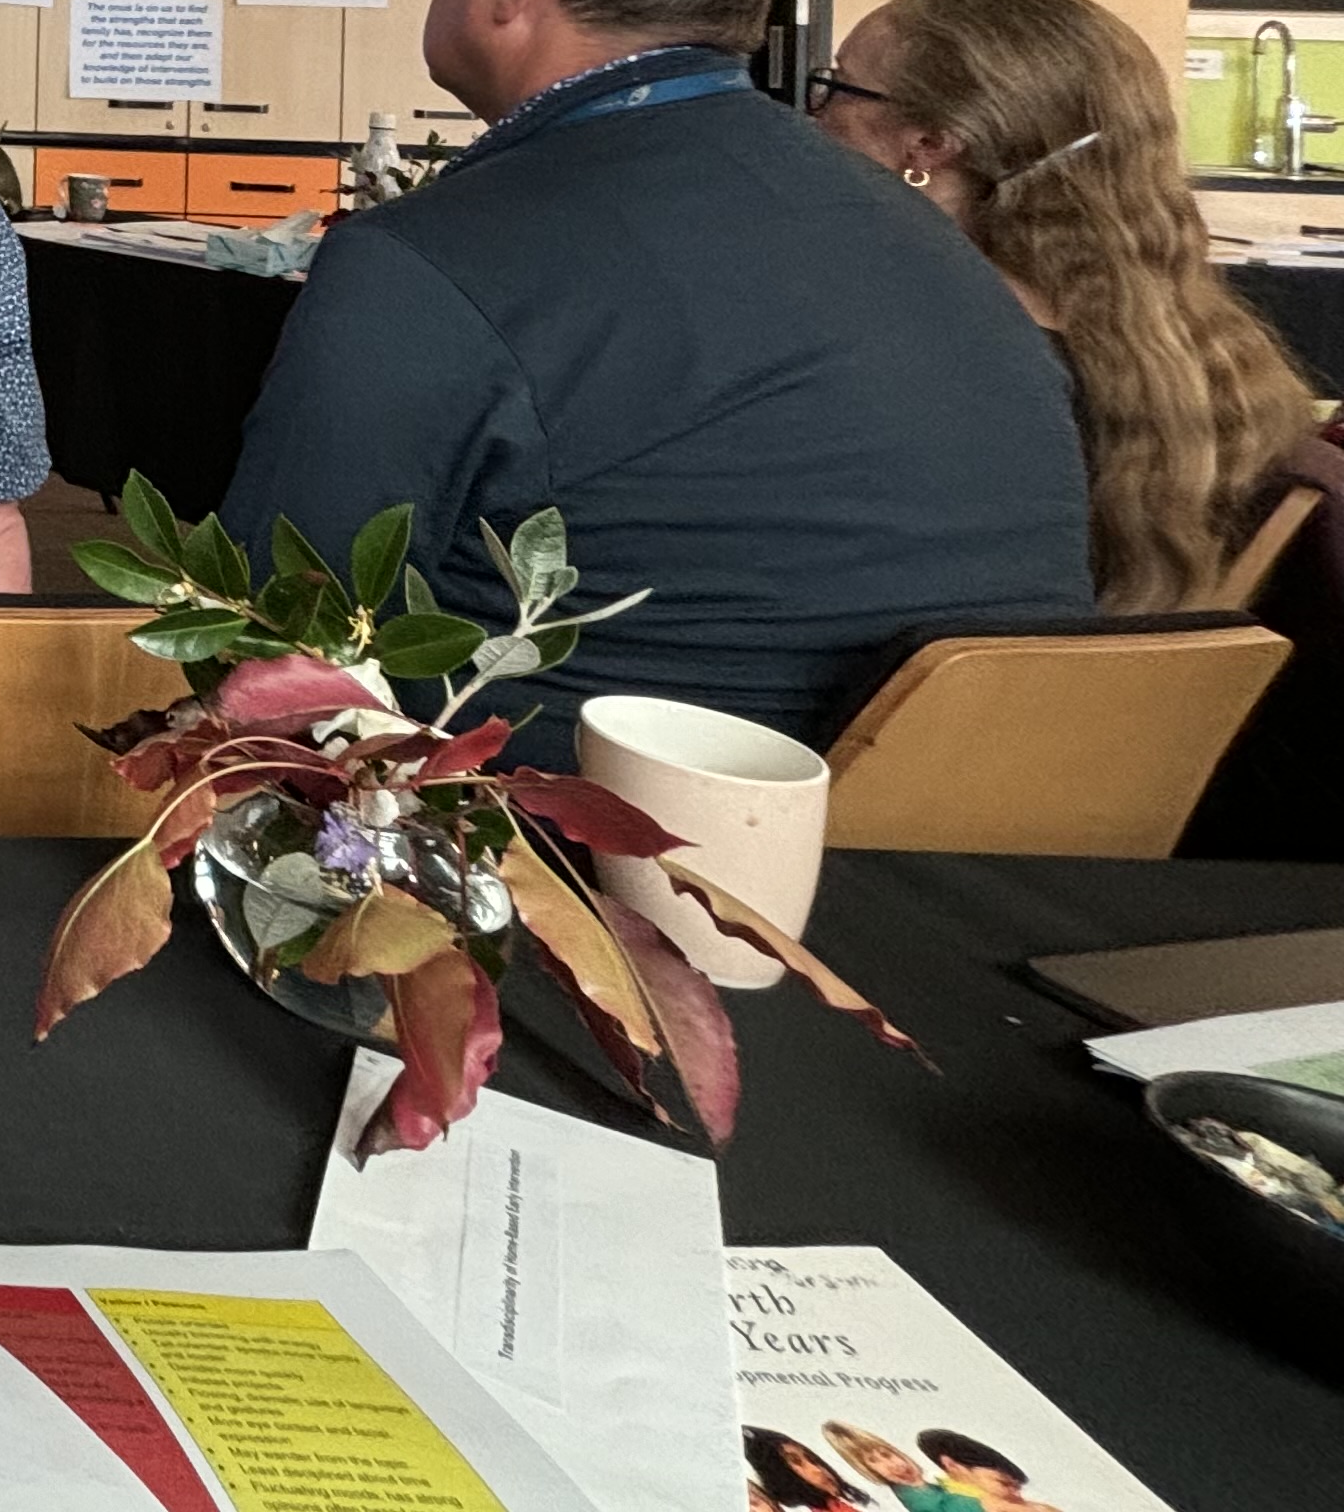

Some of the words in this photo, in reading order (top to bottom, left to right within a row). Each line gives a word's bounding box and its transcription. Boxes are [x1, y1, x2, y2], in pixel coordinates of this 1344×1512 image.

[88, 2, 105, 11] The
[91, 15, 106, 23] the
[109, 16, 155, 26] strengths
[157, 17, 176, 25] that
[81, 27, 110, 36] family
[82, 39, 97, 47] for
[99, 40, 114, 48] the
[168, 41, 188, 50] they
[99, 52, 119, 60] and
[730, 1319, 857, 1356] Years
[836, 1371, 939, 1395] Progress
[207, 1416, 244, 1426] More
[245, 1420, 272, 1430] eye
[273, 1421, 323, 1433] contact
[324, 1426, 352, 1435] and
[218, 1432, 291, 1445] expression
[228, 1446, 260, 1461] May
[261, 1451, 312, 1462] wander
[313, 1451, 348, 1464] from
[347, 1455, 373, 1467] the
[238, 1462, 280, 1475] Least
[281, 1464, 356, 1481] disciplined
[357, 1472, 399, 1485] about
[398, 1475, 433, 1488] time
[249, 1478, 331, 1499] Fluctuating
[383, 1491, 416, 1503] has
[414, 1492, 464, 1510] strong
